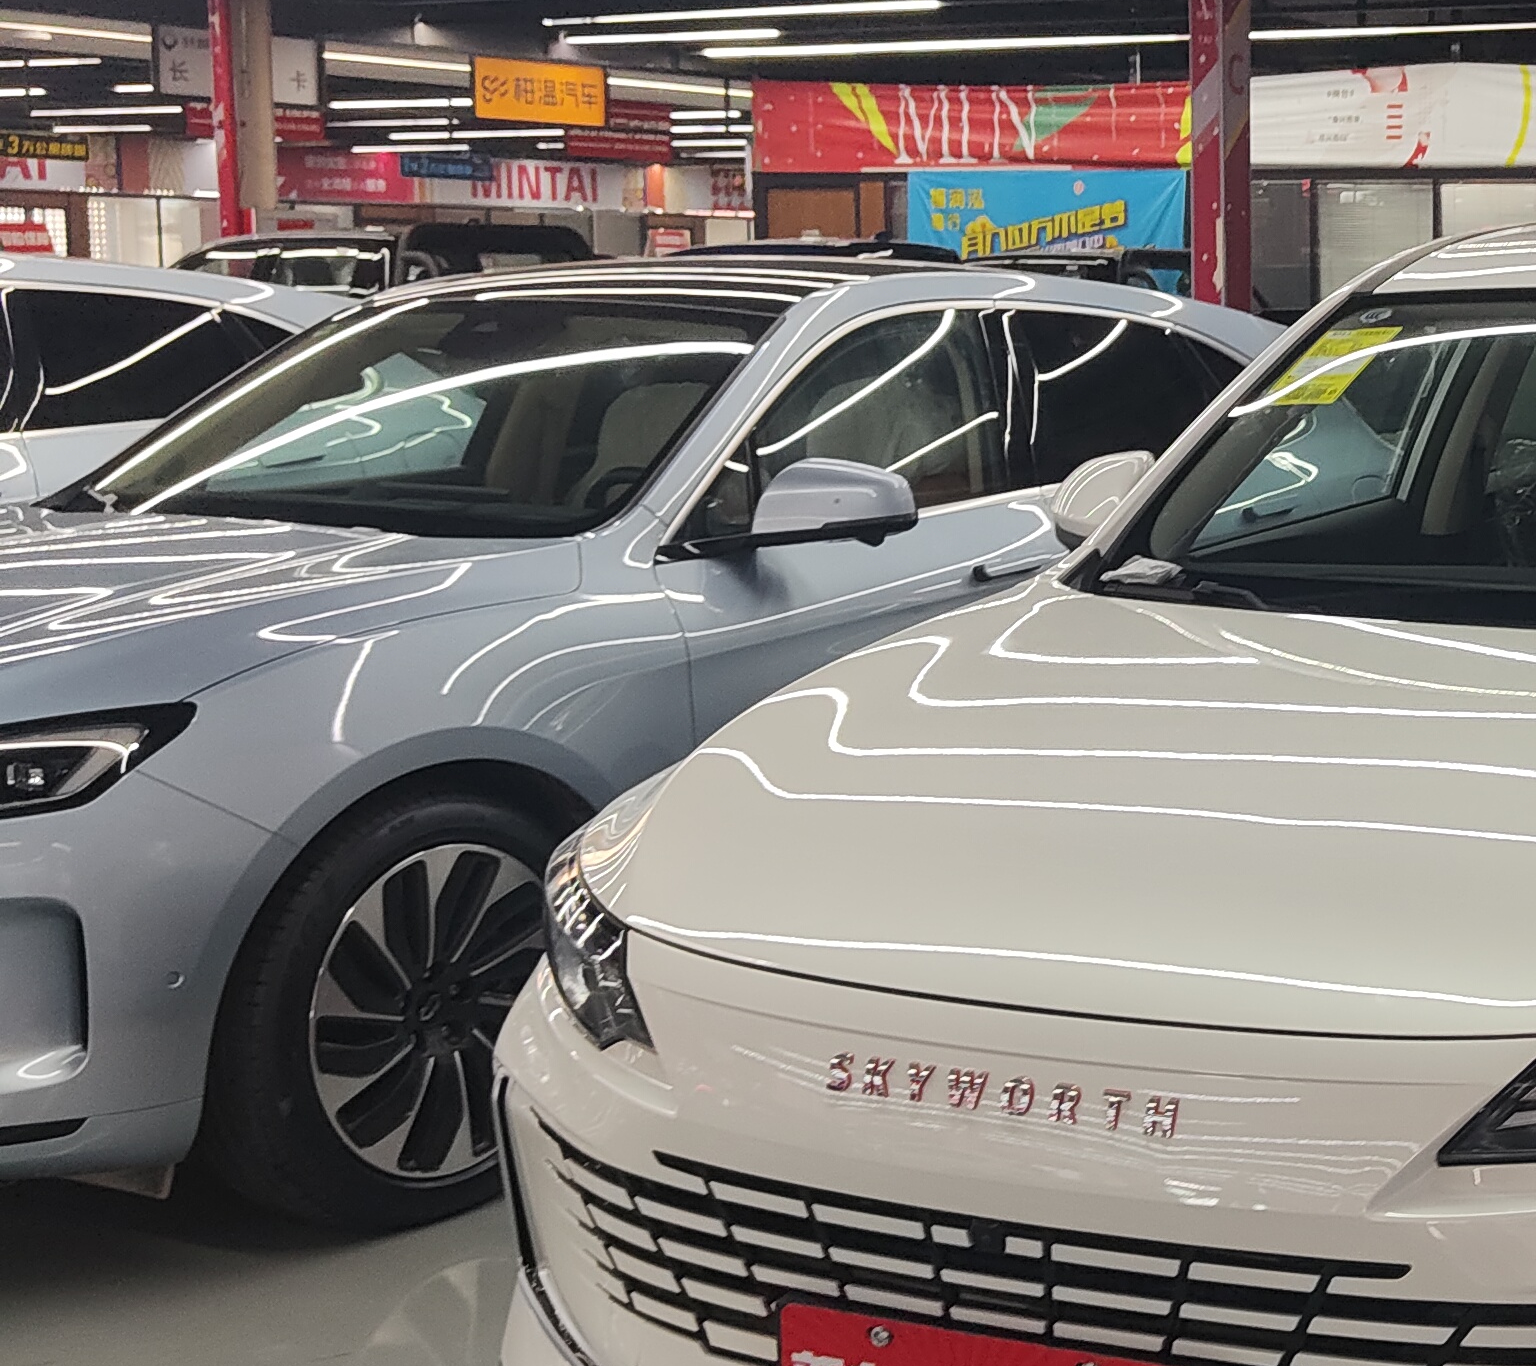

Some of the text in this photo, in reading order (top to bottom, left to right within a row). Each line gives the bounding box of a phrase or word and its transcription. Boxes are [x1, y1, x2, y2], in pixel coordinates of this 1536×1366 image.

[894, 84, 1037, 164] MIN
[470, 161, 598, 203] MINTAI
[825, 1051, 1180, 1139] SKYWORTH
